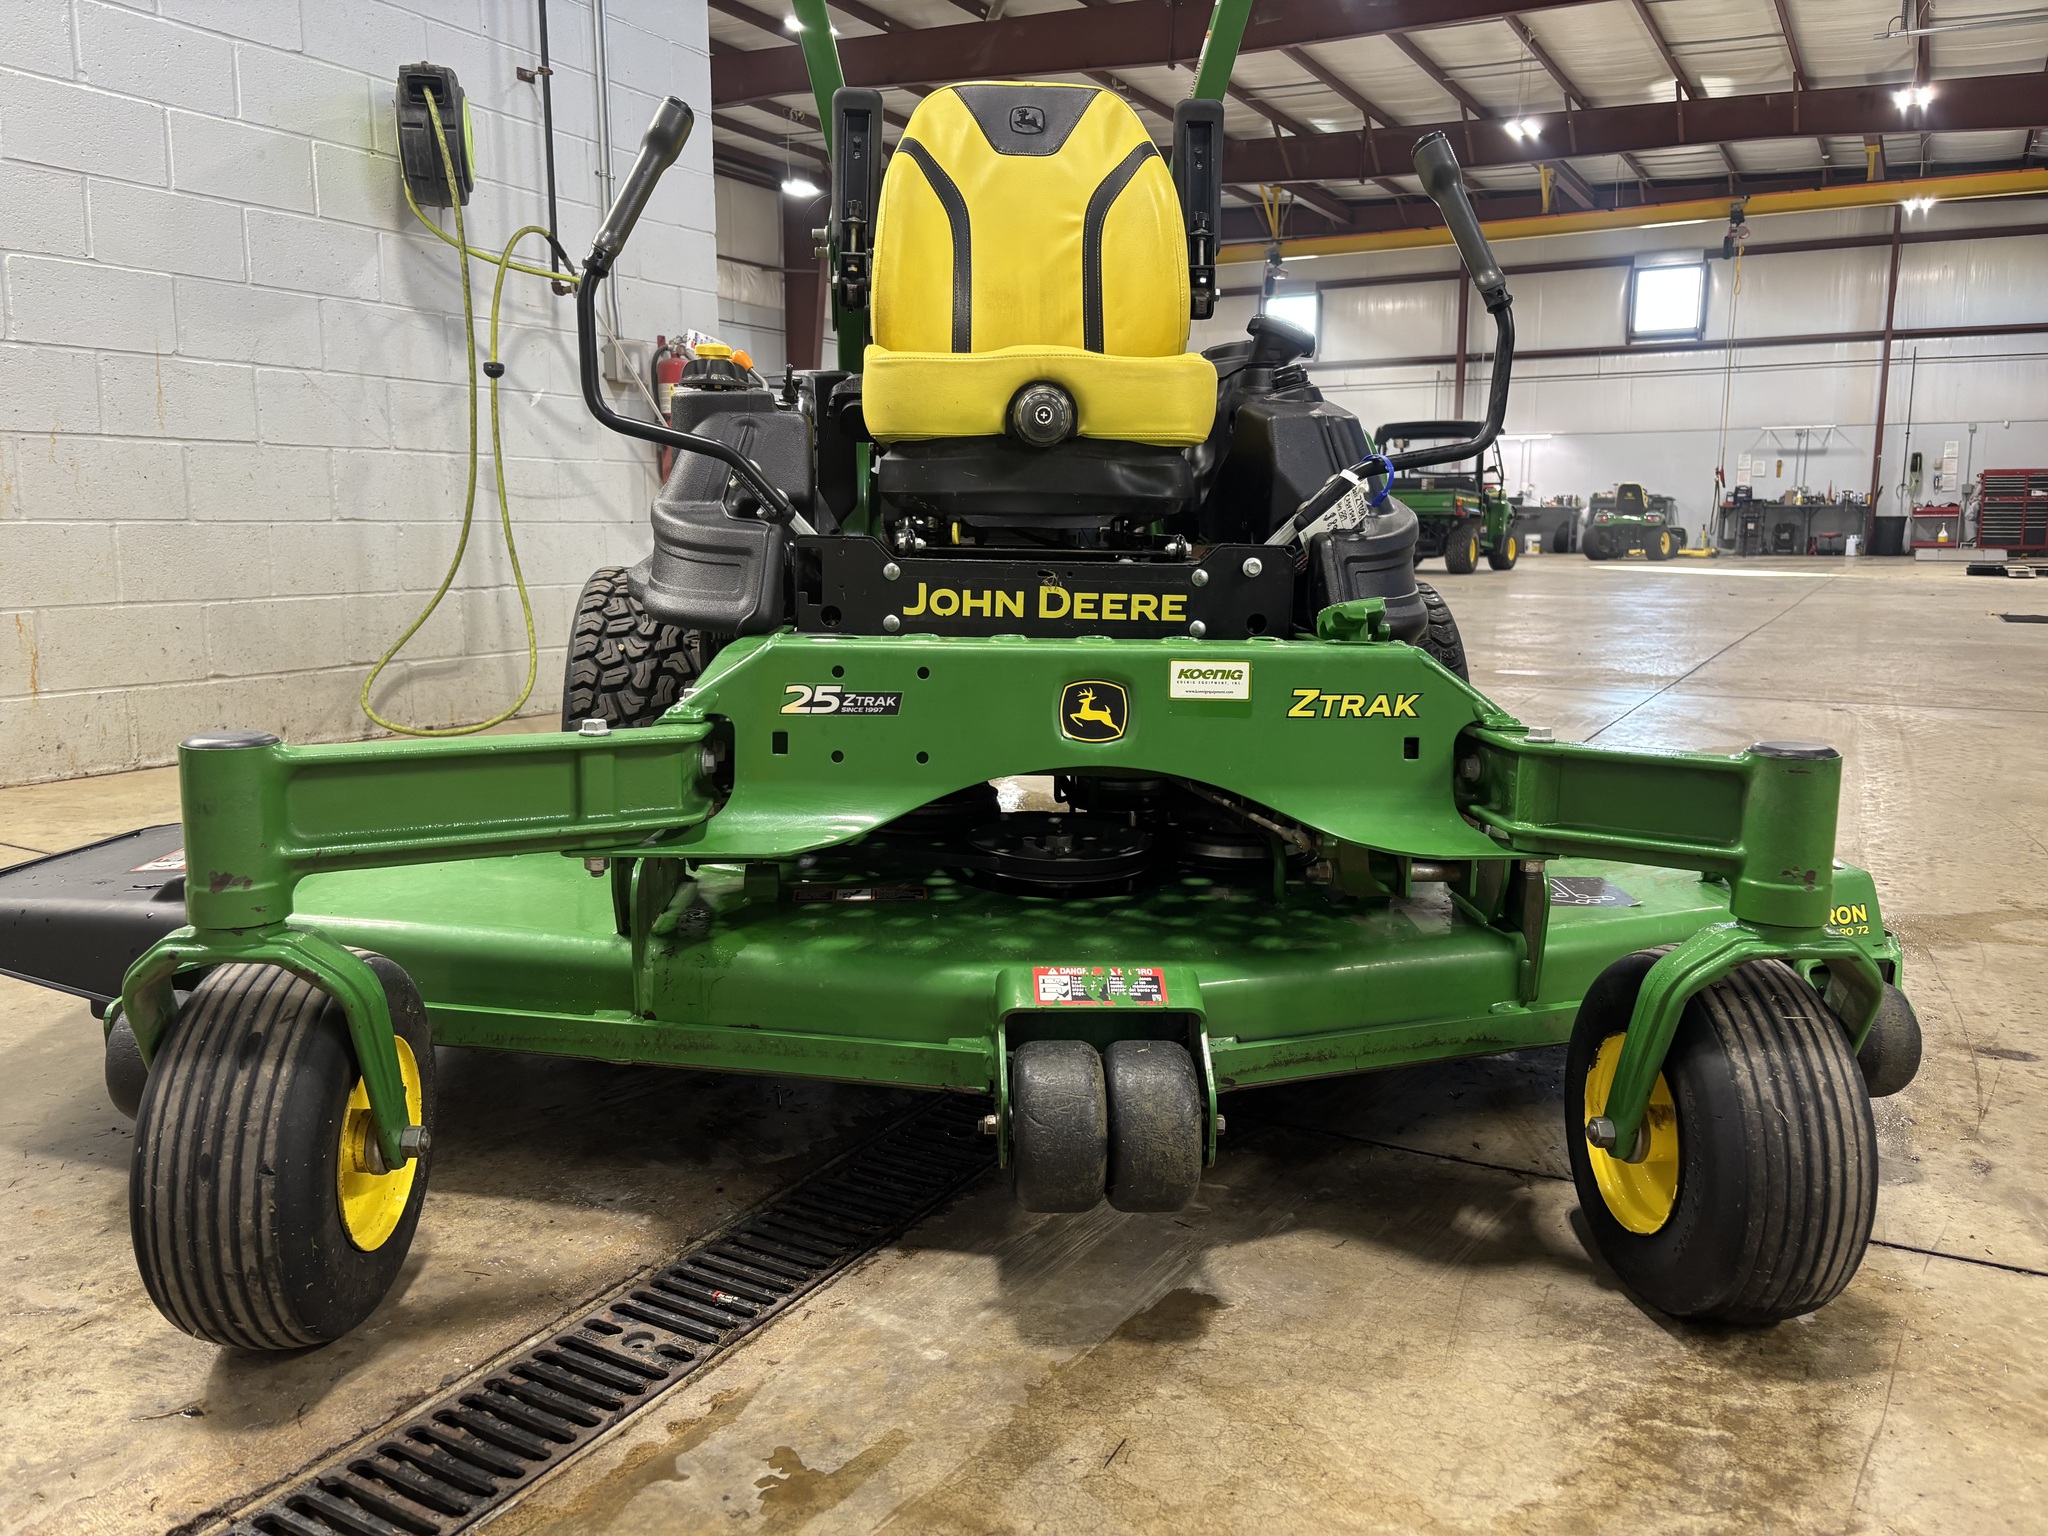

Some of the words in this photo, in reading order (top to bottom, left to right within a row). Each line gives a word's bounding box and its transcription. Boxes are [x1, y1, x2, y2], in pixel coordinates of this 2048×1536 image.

[902, 582, 1025, 617] JOHN
[1038, 585, 1188, 622] DEERE
[780, 684, 842, 714] 25
[842, 694, 897, 706] ZTRAK
[1288, 689, 1422, 718] ZTRAK
[1857, 926, 1870, 935] 72
